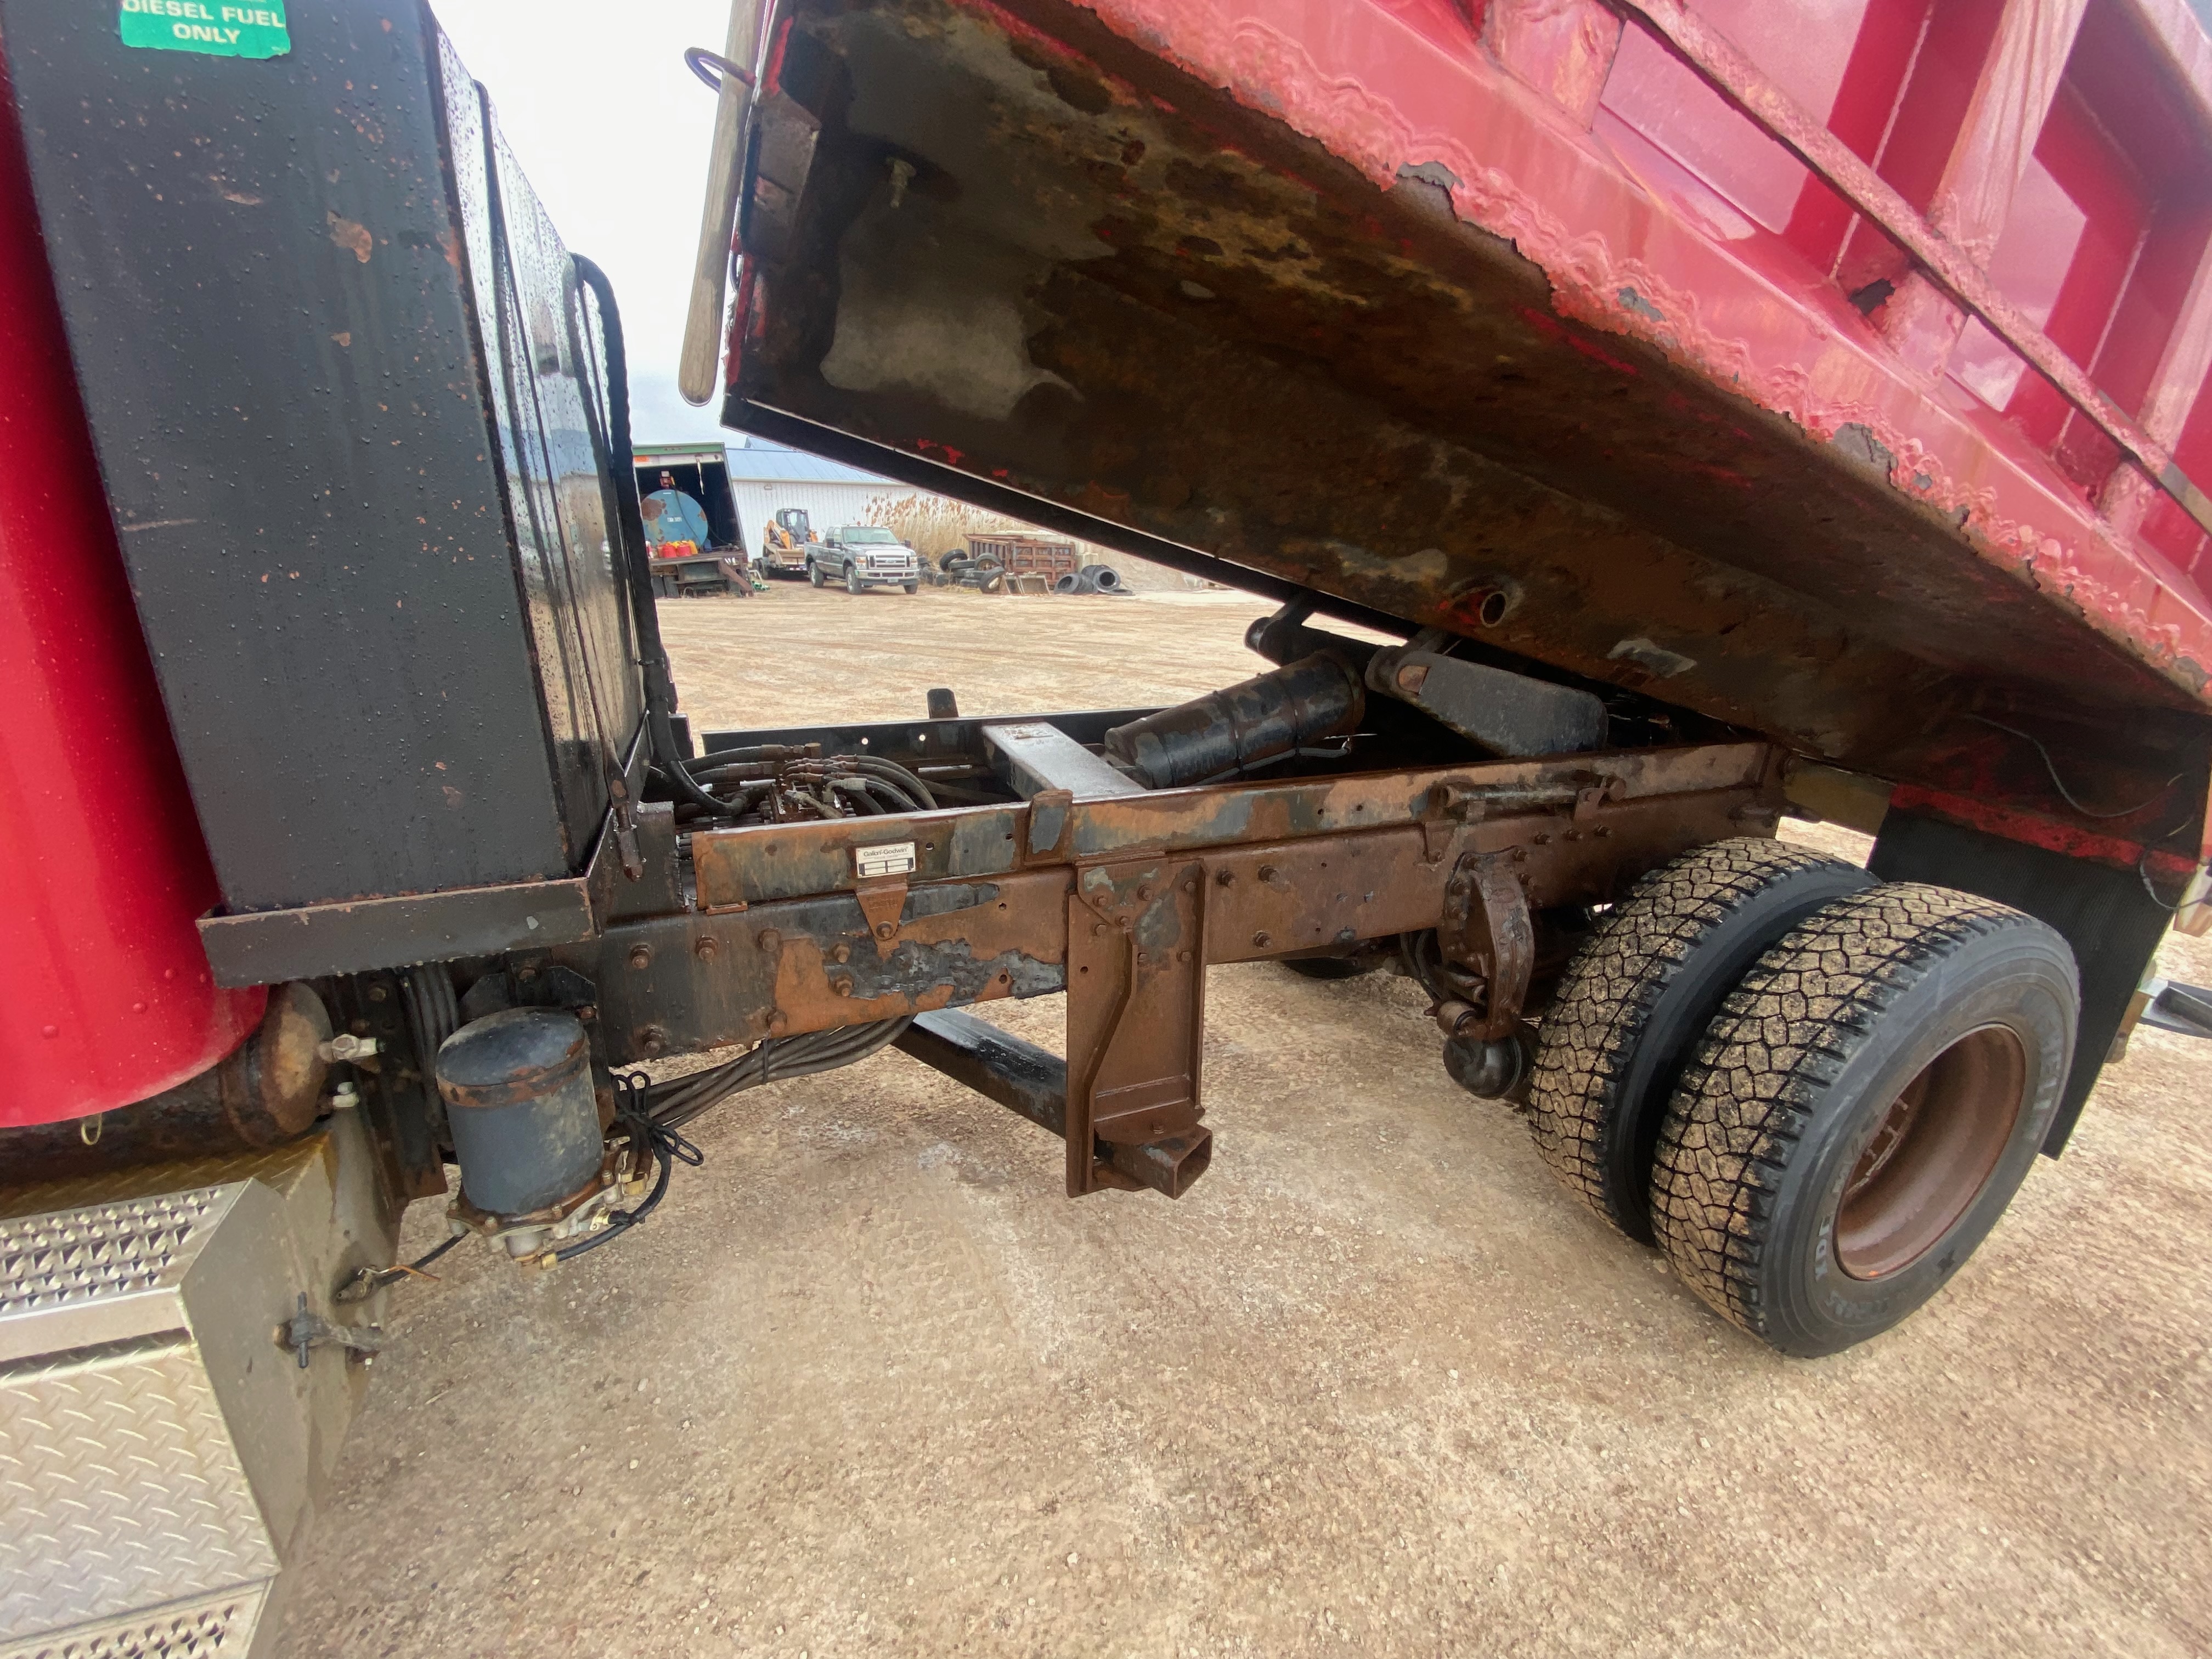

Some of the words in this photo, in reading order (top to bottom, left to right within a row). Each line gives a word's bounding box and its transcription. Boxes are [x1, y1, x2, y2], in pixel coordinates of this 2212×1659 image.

[122, 0, 214, 20] DIESEL
[221, 5, 285, 28] FUEL
[172, 22, 241, 44] ONLY
